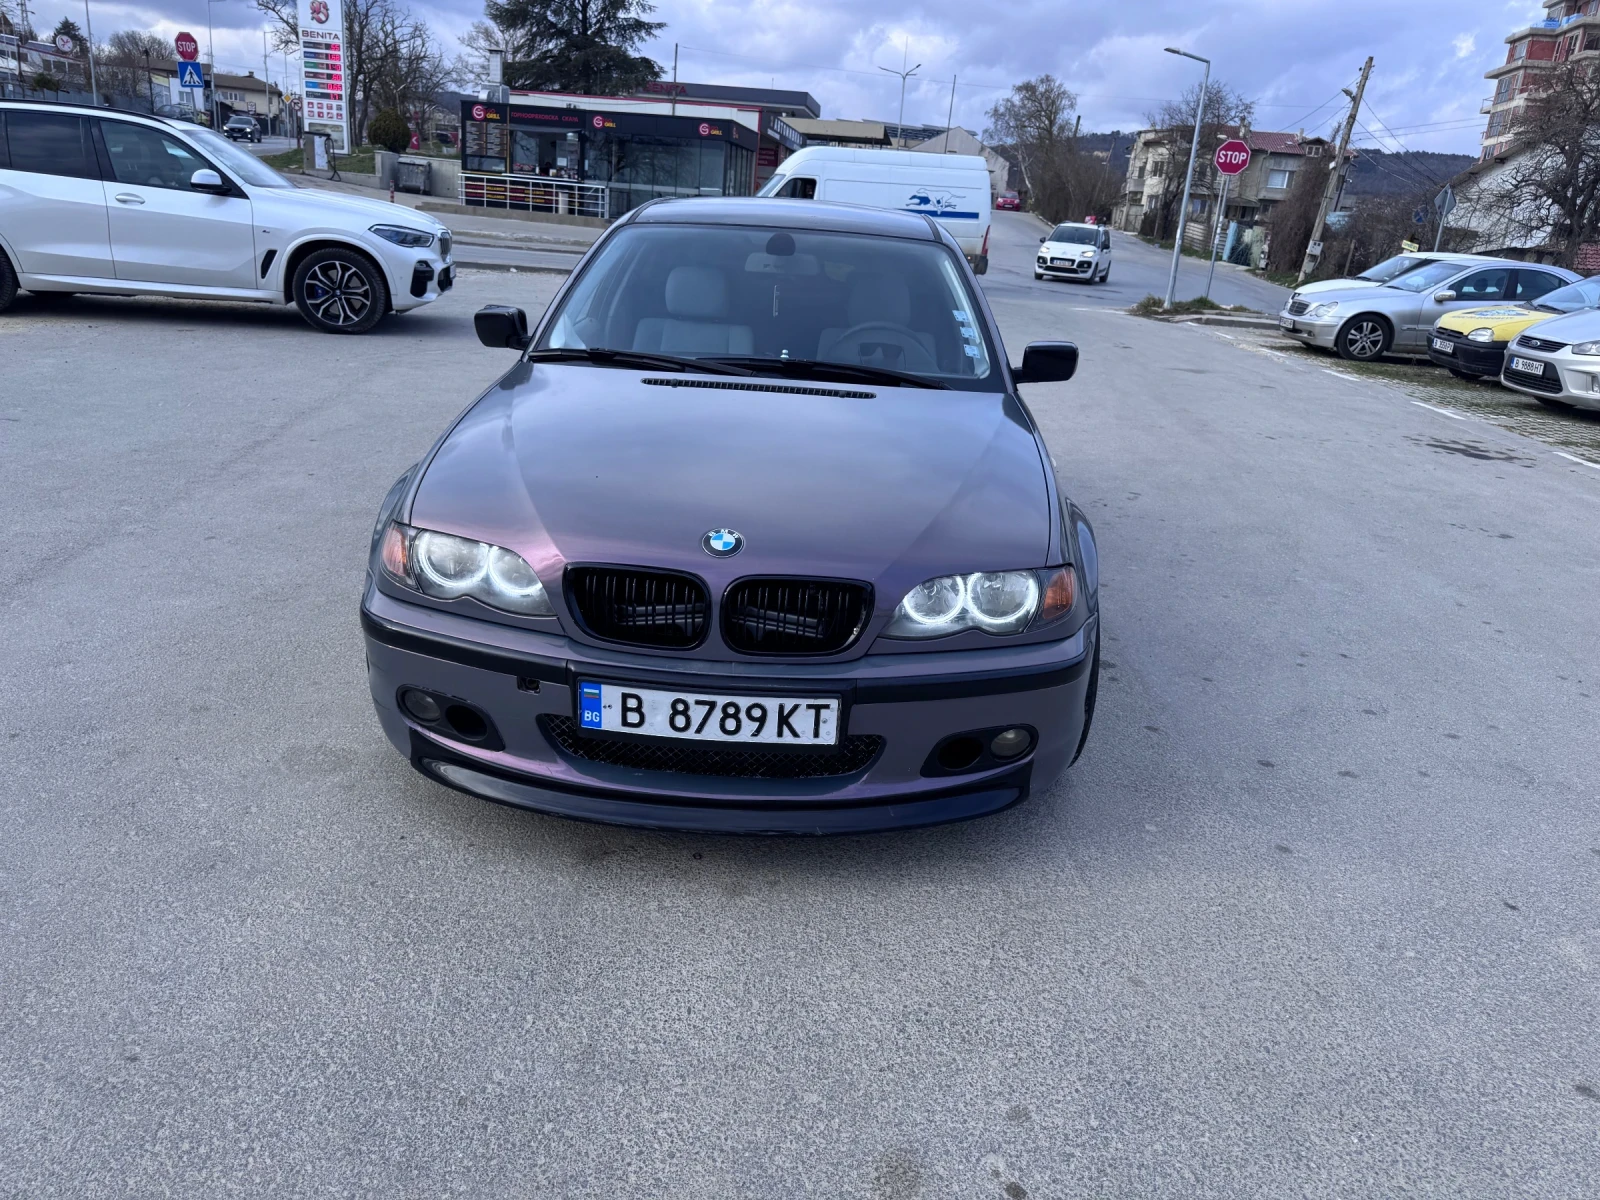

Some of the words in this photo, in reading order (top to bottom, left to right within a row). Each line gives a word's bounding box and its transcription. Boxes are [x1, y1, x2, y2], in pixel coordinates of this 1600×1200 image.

[301, 29, 340, 40] BENITA
[177, 41, 196, 52] STOP
[1218, 150, 1247, 164] STOP
[584, 710, 600, 723] BG
[621, 692, 646, 729] B
